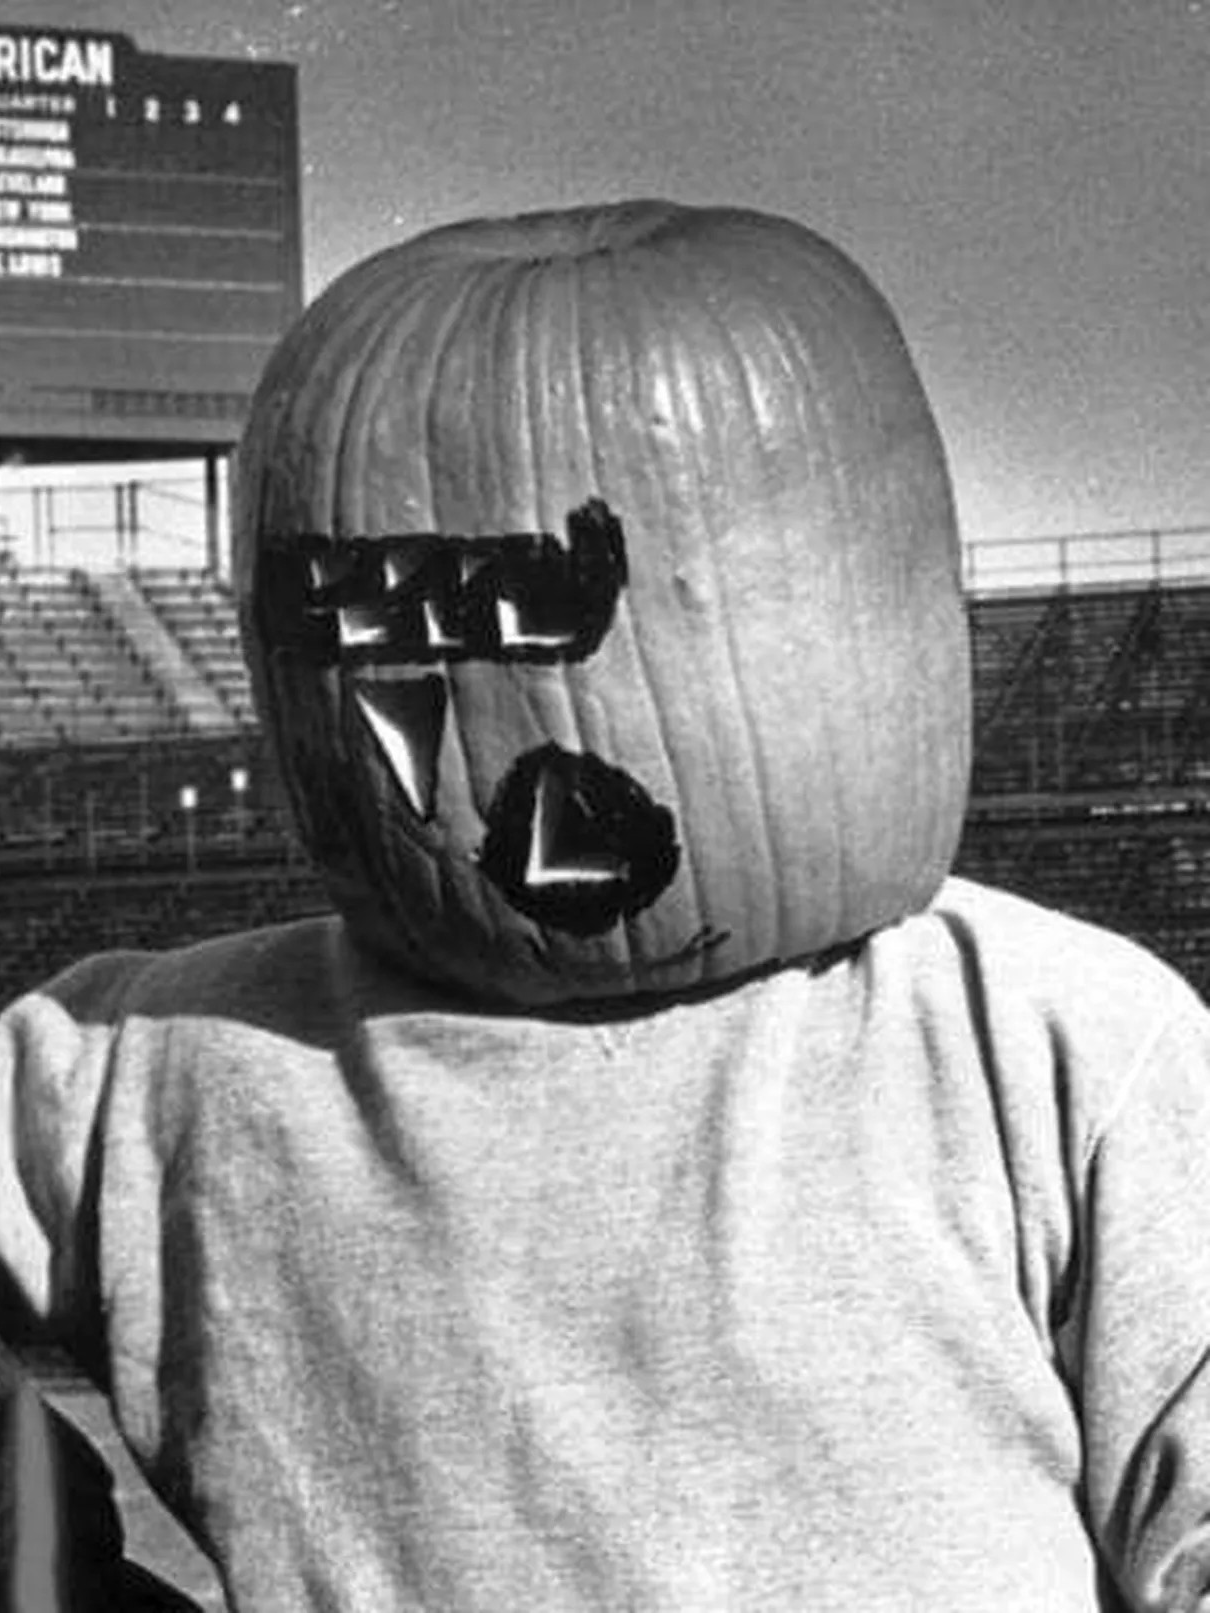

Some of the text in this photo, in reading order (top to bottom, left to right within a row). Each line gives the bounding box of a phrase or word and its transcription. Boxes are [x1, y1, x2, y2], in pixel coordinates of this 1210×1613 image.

[106, 95, 117, 119] 1
[145, 97, 160, 123] 2
[185, 99, 200, 124] 3
[223, 100, 239, 126] 4
